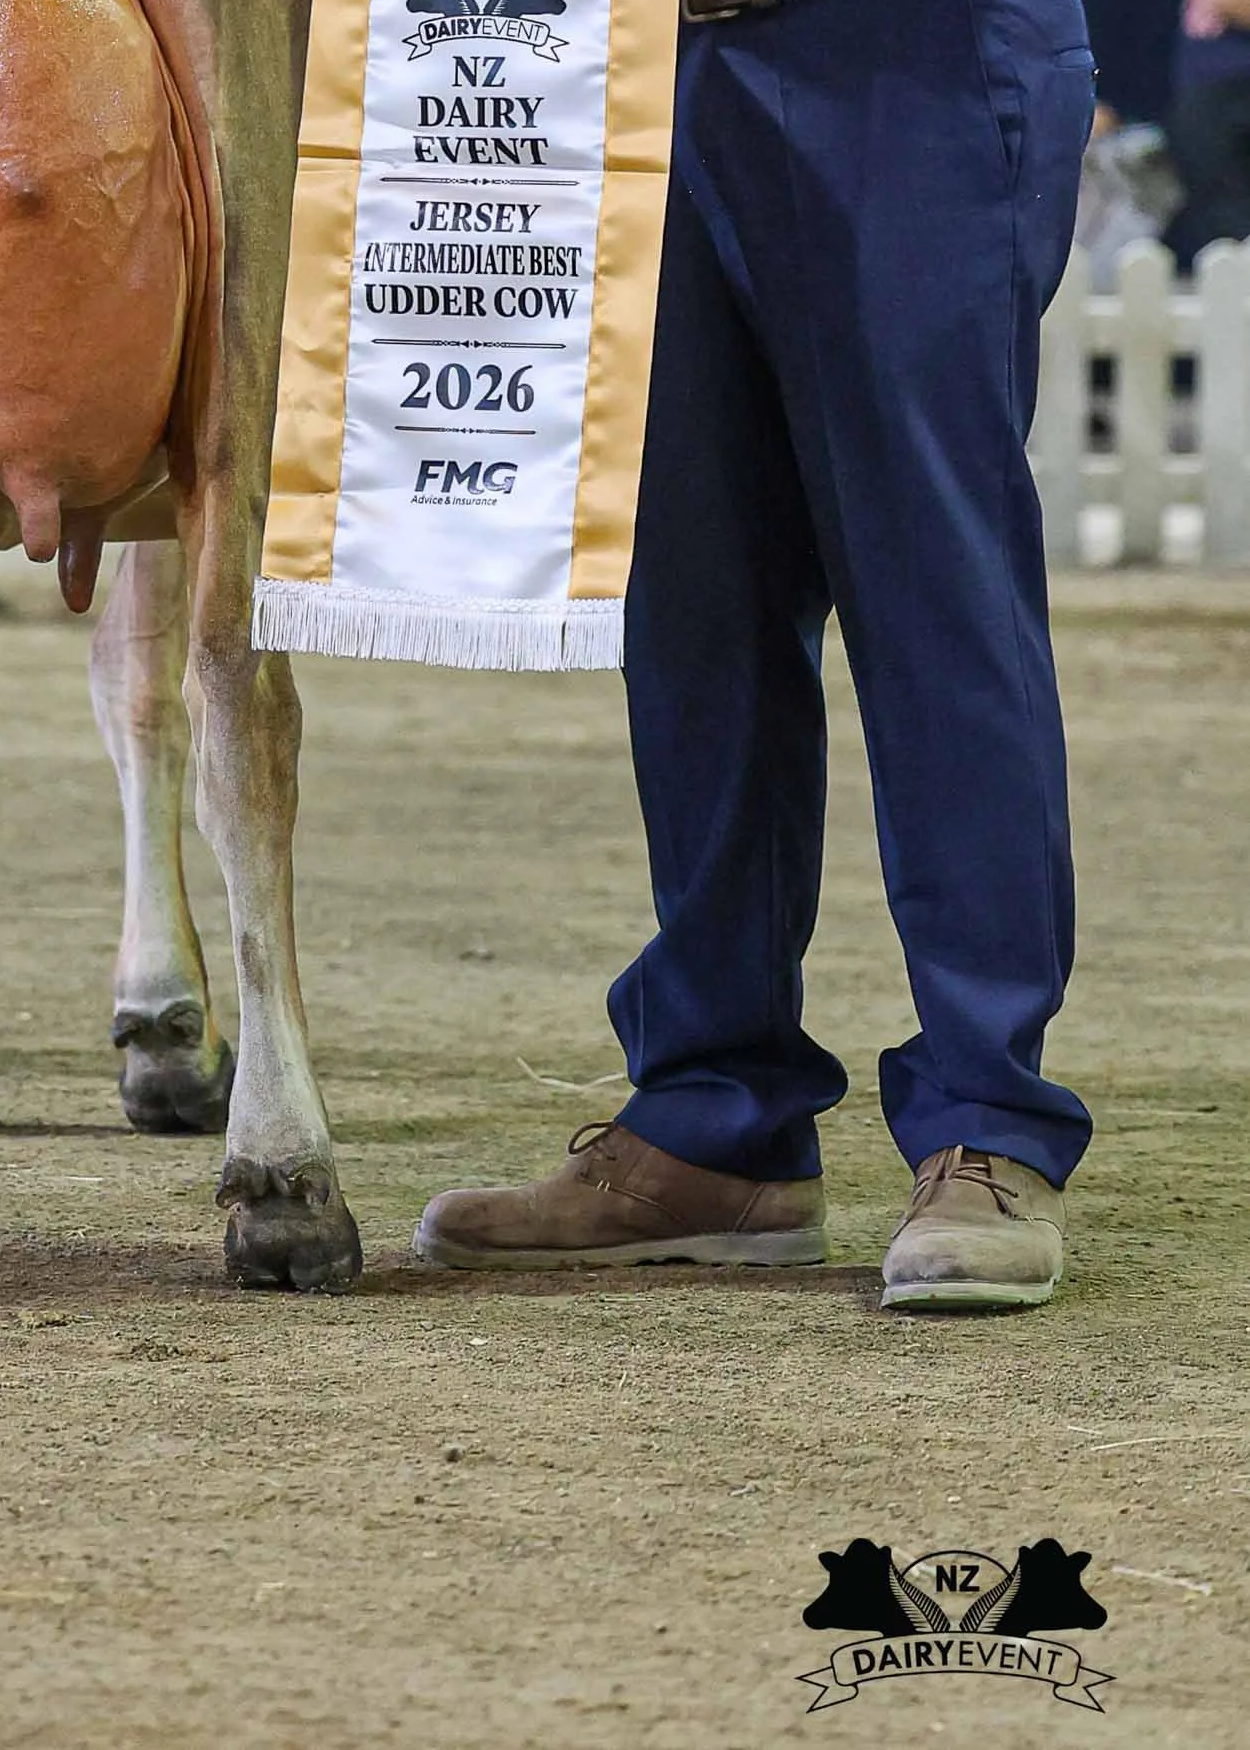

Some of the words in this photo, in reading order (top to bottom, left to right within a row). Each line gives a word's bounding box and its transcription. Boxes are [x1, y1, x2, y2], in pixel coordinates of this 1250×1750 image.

[452, 56, 506, 88] NZ
[417, 95, 545, 129] DAIRY
[413, 135, 548, 165] EVENT
[410, 200, 541, 234] JERSEY
[364, 242, 525, 276] INTERMEDIATE
[529, 246, 582, 277] BEST
[364, 283, 487, 317] UDDER
[493, 287, 578, 319] COW
[400, 362, 535, 412] 2026
[414, 459, 519, 495] FMG
[410, 495, 443, 505] Advice
[444, 496, 451, 505] &
[452, 496, 498, 506] Insurance
